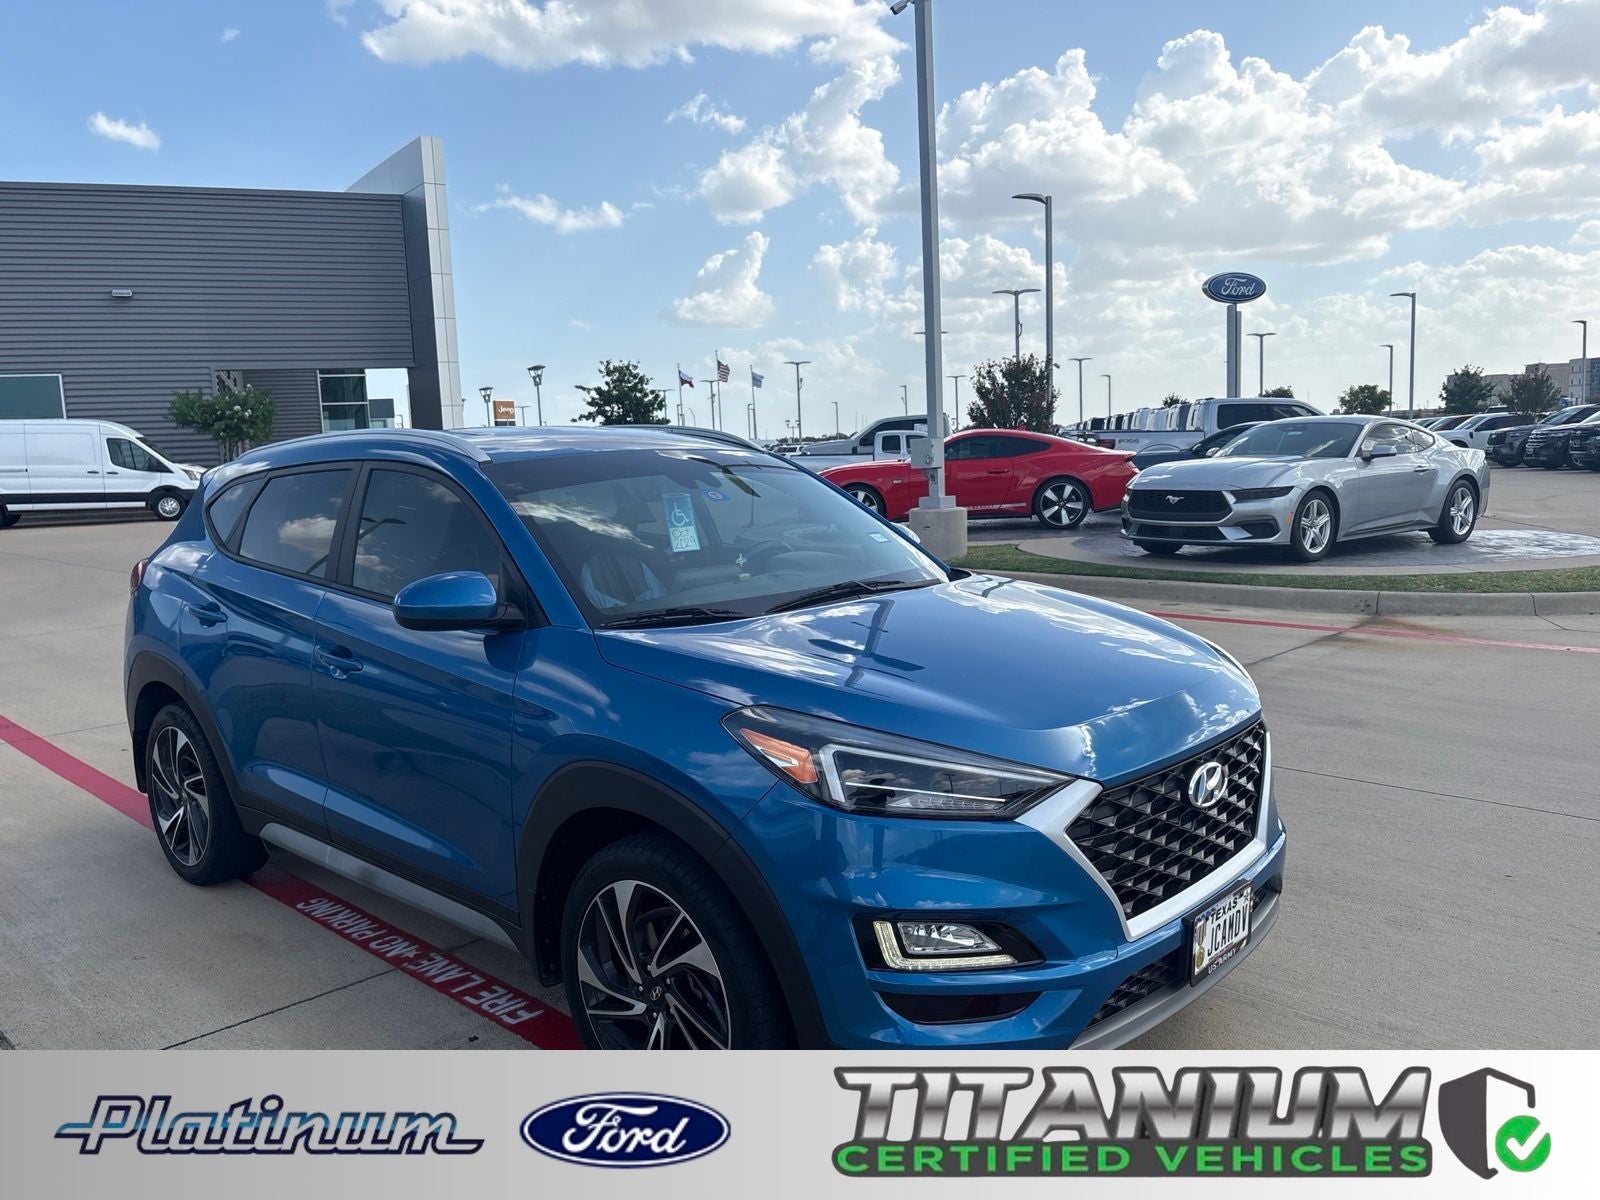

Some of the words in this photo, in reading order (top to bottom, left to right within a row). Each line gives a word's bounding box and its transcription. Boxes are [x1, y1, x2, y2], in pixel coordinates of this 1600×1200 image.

[1221, 278, 1255, 296] Ford
[498, 405, 515, 414] Jeep
[297, 898, 389, 941] PARKING
[1210, 897, 1238, 924] TEXAS
[368, 937, 414, 958] NO
[407, 952, 486, 993] LANE
[464, 985, 544, 1024] FIRE
